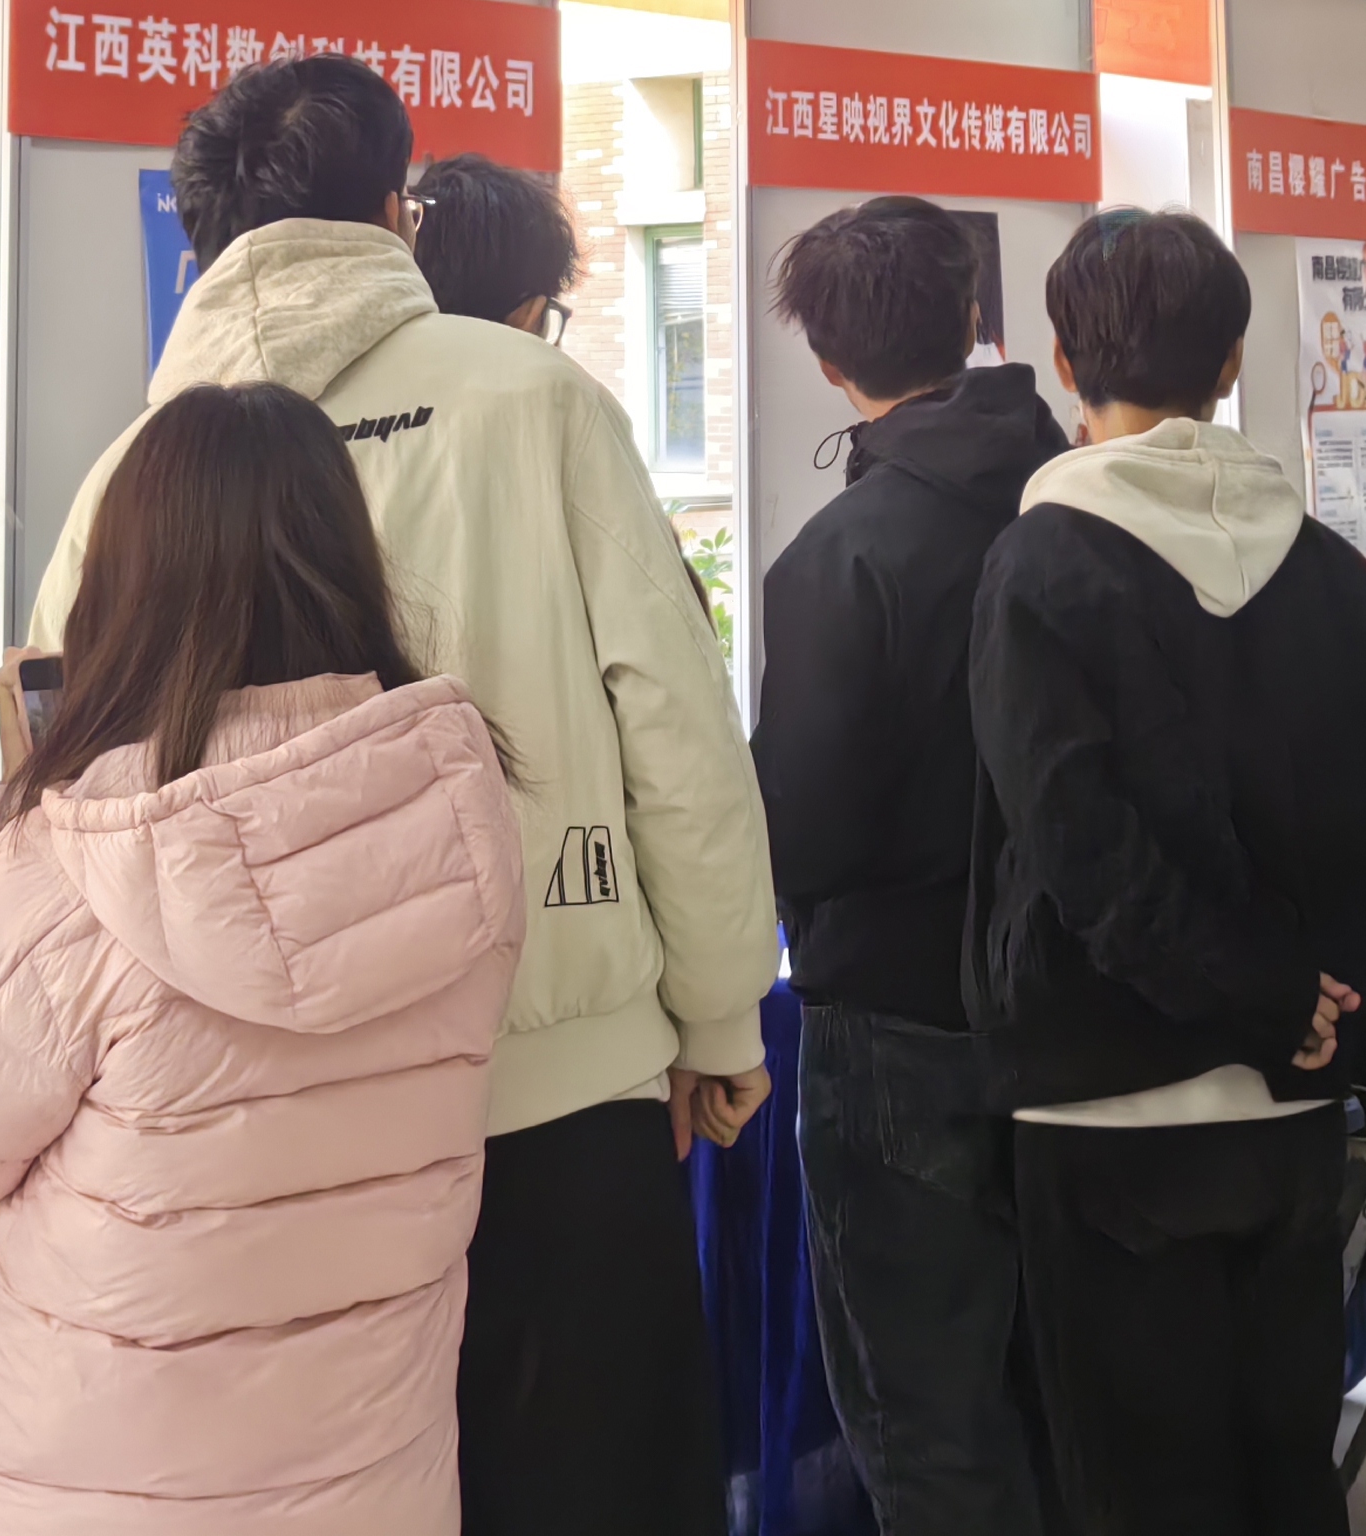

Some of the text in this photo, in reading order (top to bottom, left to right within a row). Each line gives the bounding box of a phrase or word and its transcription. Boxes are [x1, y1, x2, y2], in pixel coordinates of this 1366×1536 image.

[45, 6, 534, 117] 江西英科数有限公司
[765, 86, 1092, 160] 江西星映视界文化传媒有限公司
